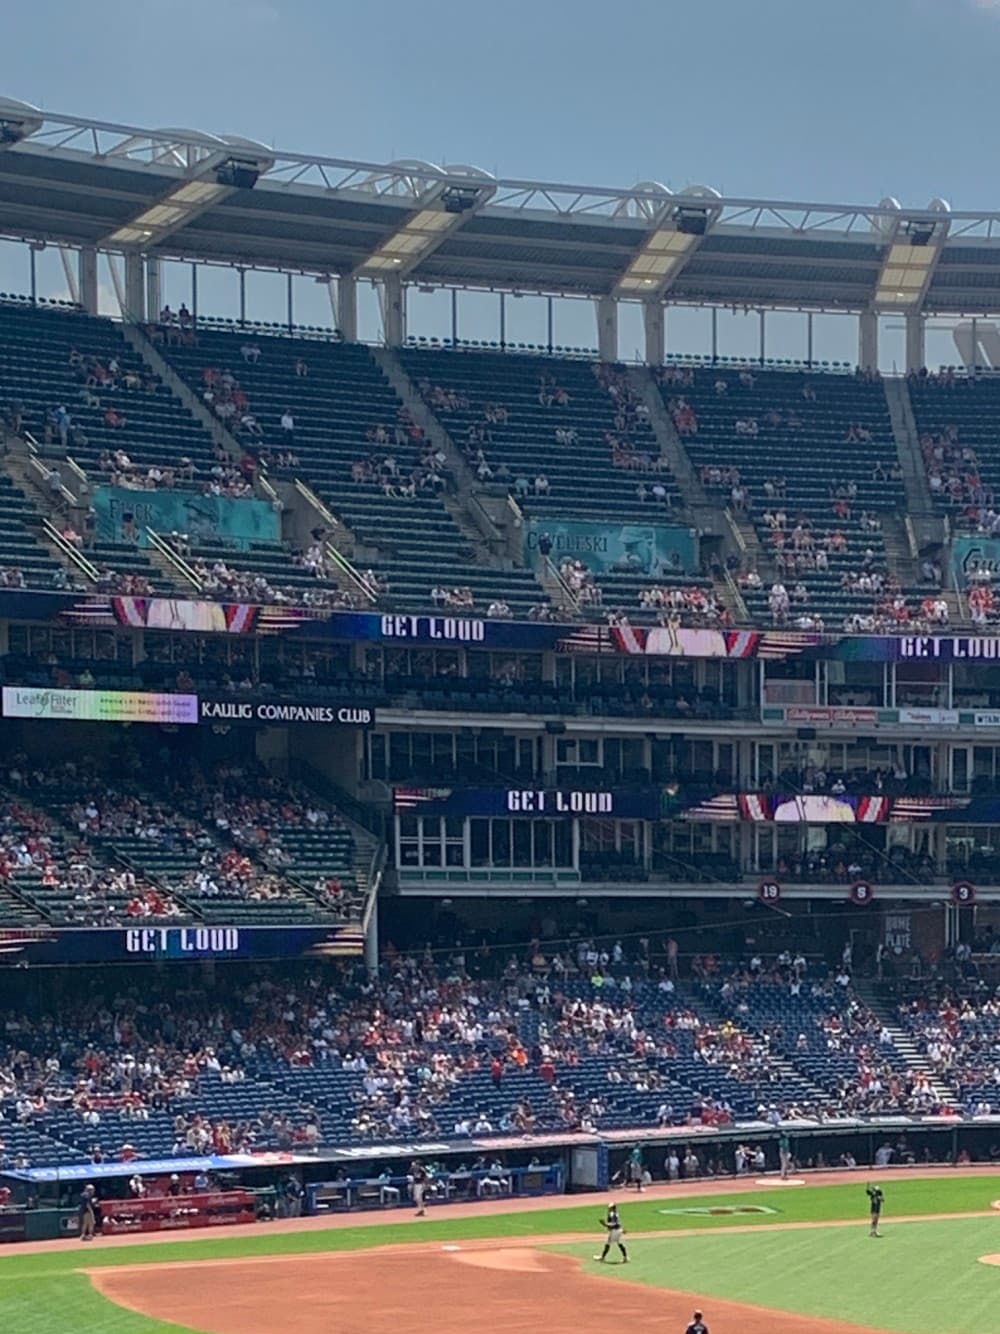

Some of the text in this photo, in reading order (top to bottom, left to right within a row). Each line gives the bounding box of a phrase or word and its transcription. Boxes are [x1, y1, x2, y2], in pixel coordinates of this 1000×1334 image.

[381, 615, 484, 641] GET LOUD
[901, 637, 940, 657] GET
[201, 702, 252, 719] KAULIG
[257, 704, 334, 722] COMPANIES
[338, 708, 371, 723] CLUB
[507, 790, 613, 813] GET LOUD
[763, 886, 778, 898] 19
[959, 887, 969, 899] 3
[126, 928, 238, 953] GET LOUD
